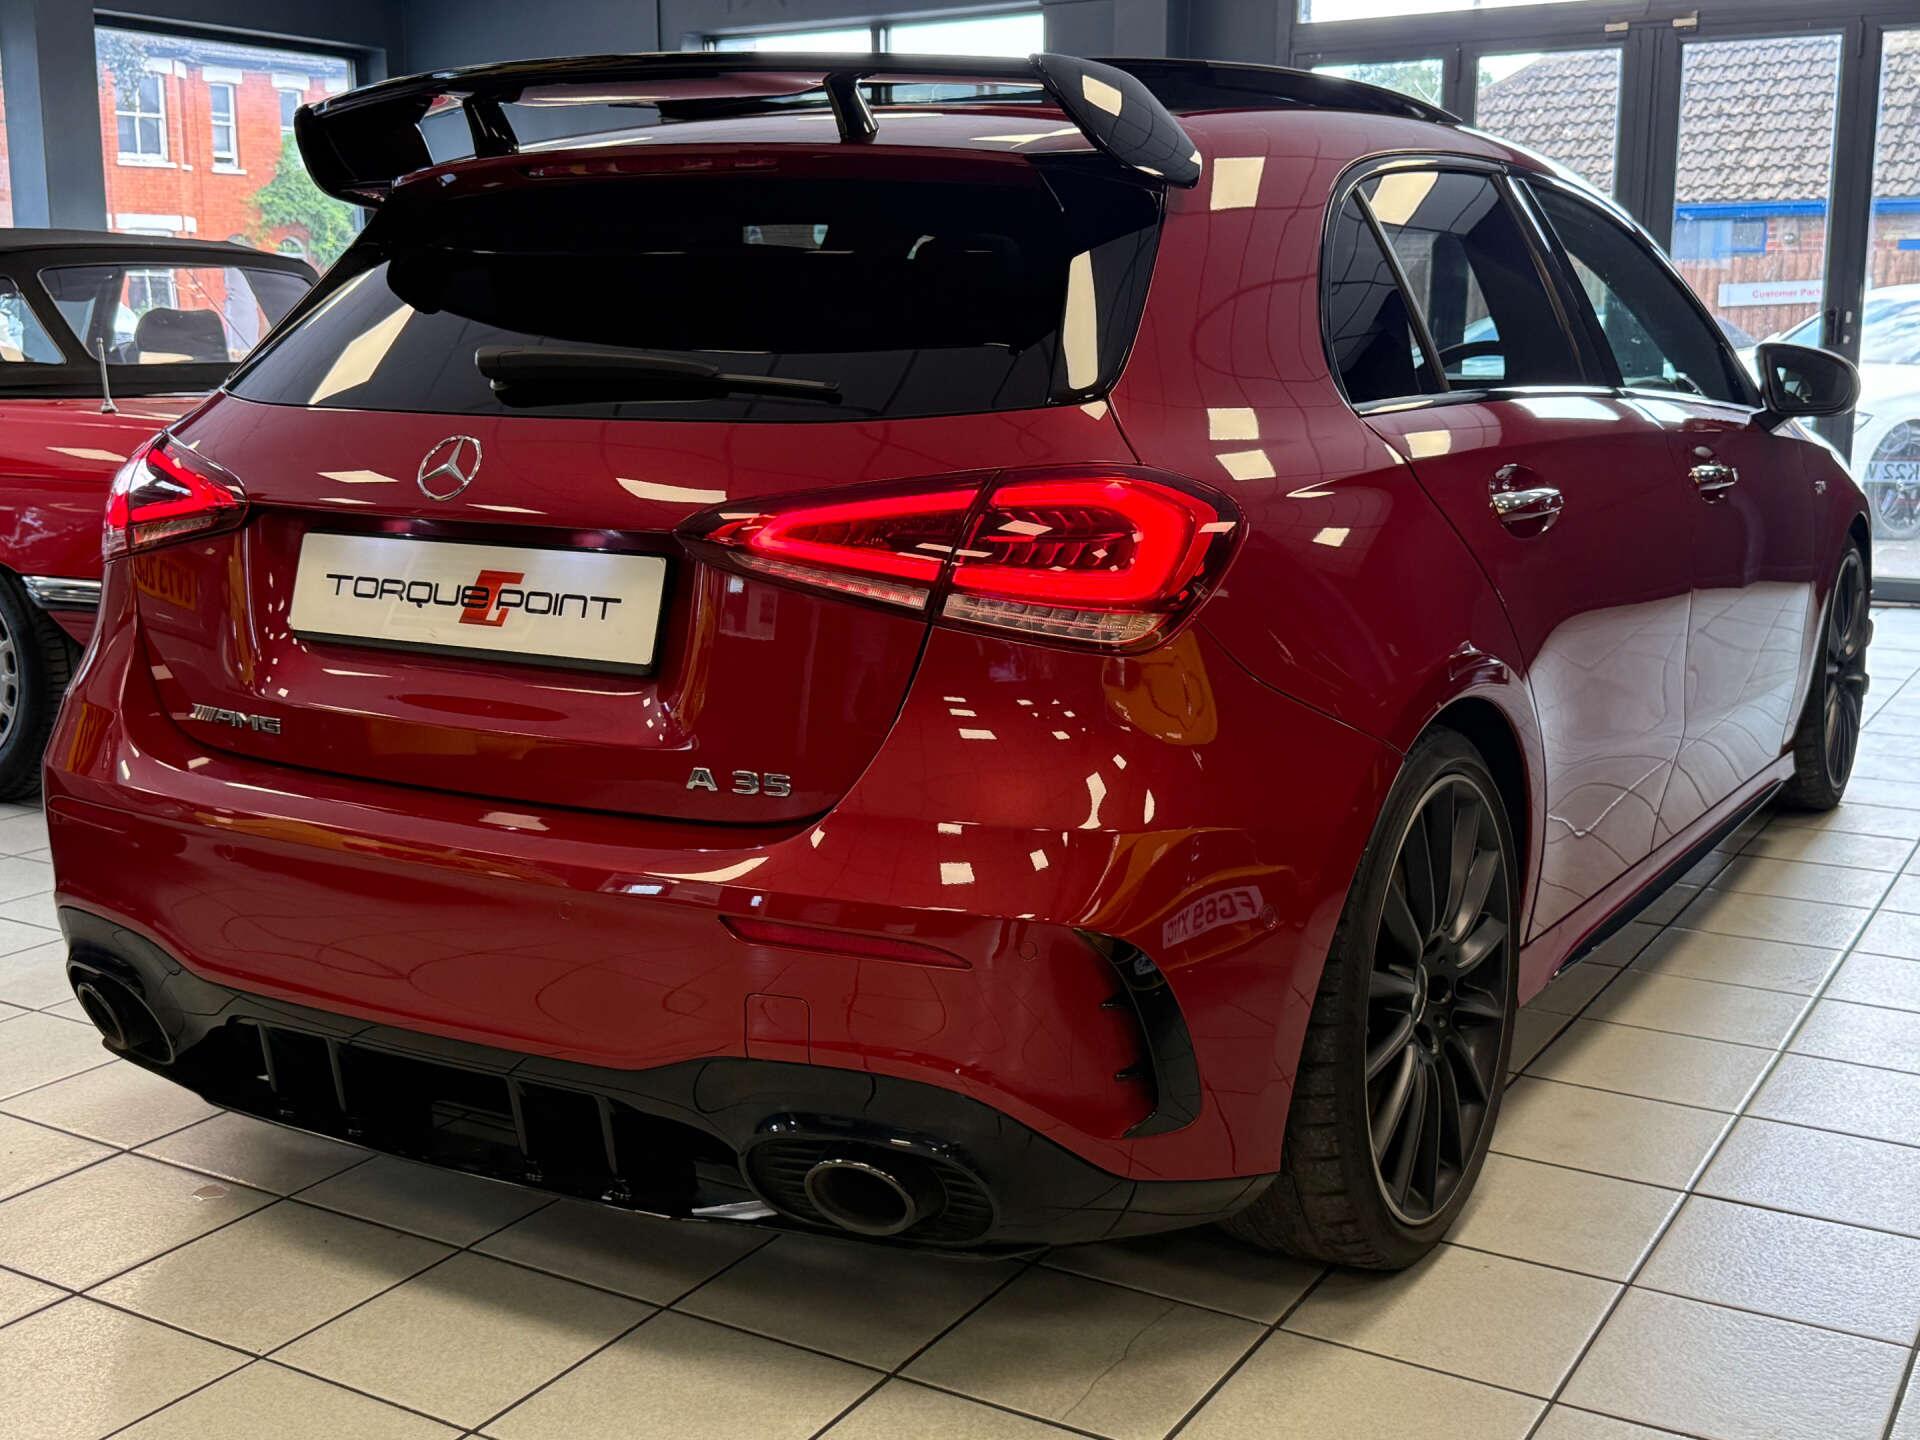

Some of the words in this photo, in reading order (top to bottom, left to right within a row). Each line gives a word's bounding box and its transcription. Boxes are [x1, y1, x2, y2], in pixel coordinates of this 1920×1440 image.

[1752, 289, 1797, 298] Customer
[326, 573, 489, 608] TORQUE
[495, 589, 622, 620] POINT
[213, 707, 281, 735] AMG
[686, 767, 718, 792] A
[731, 770, 791, 797] 35
